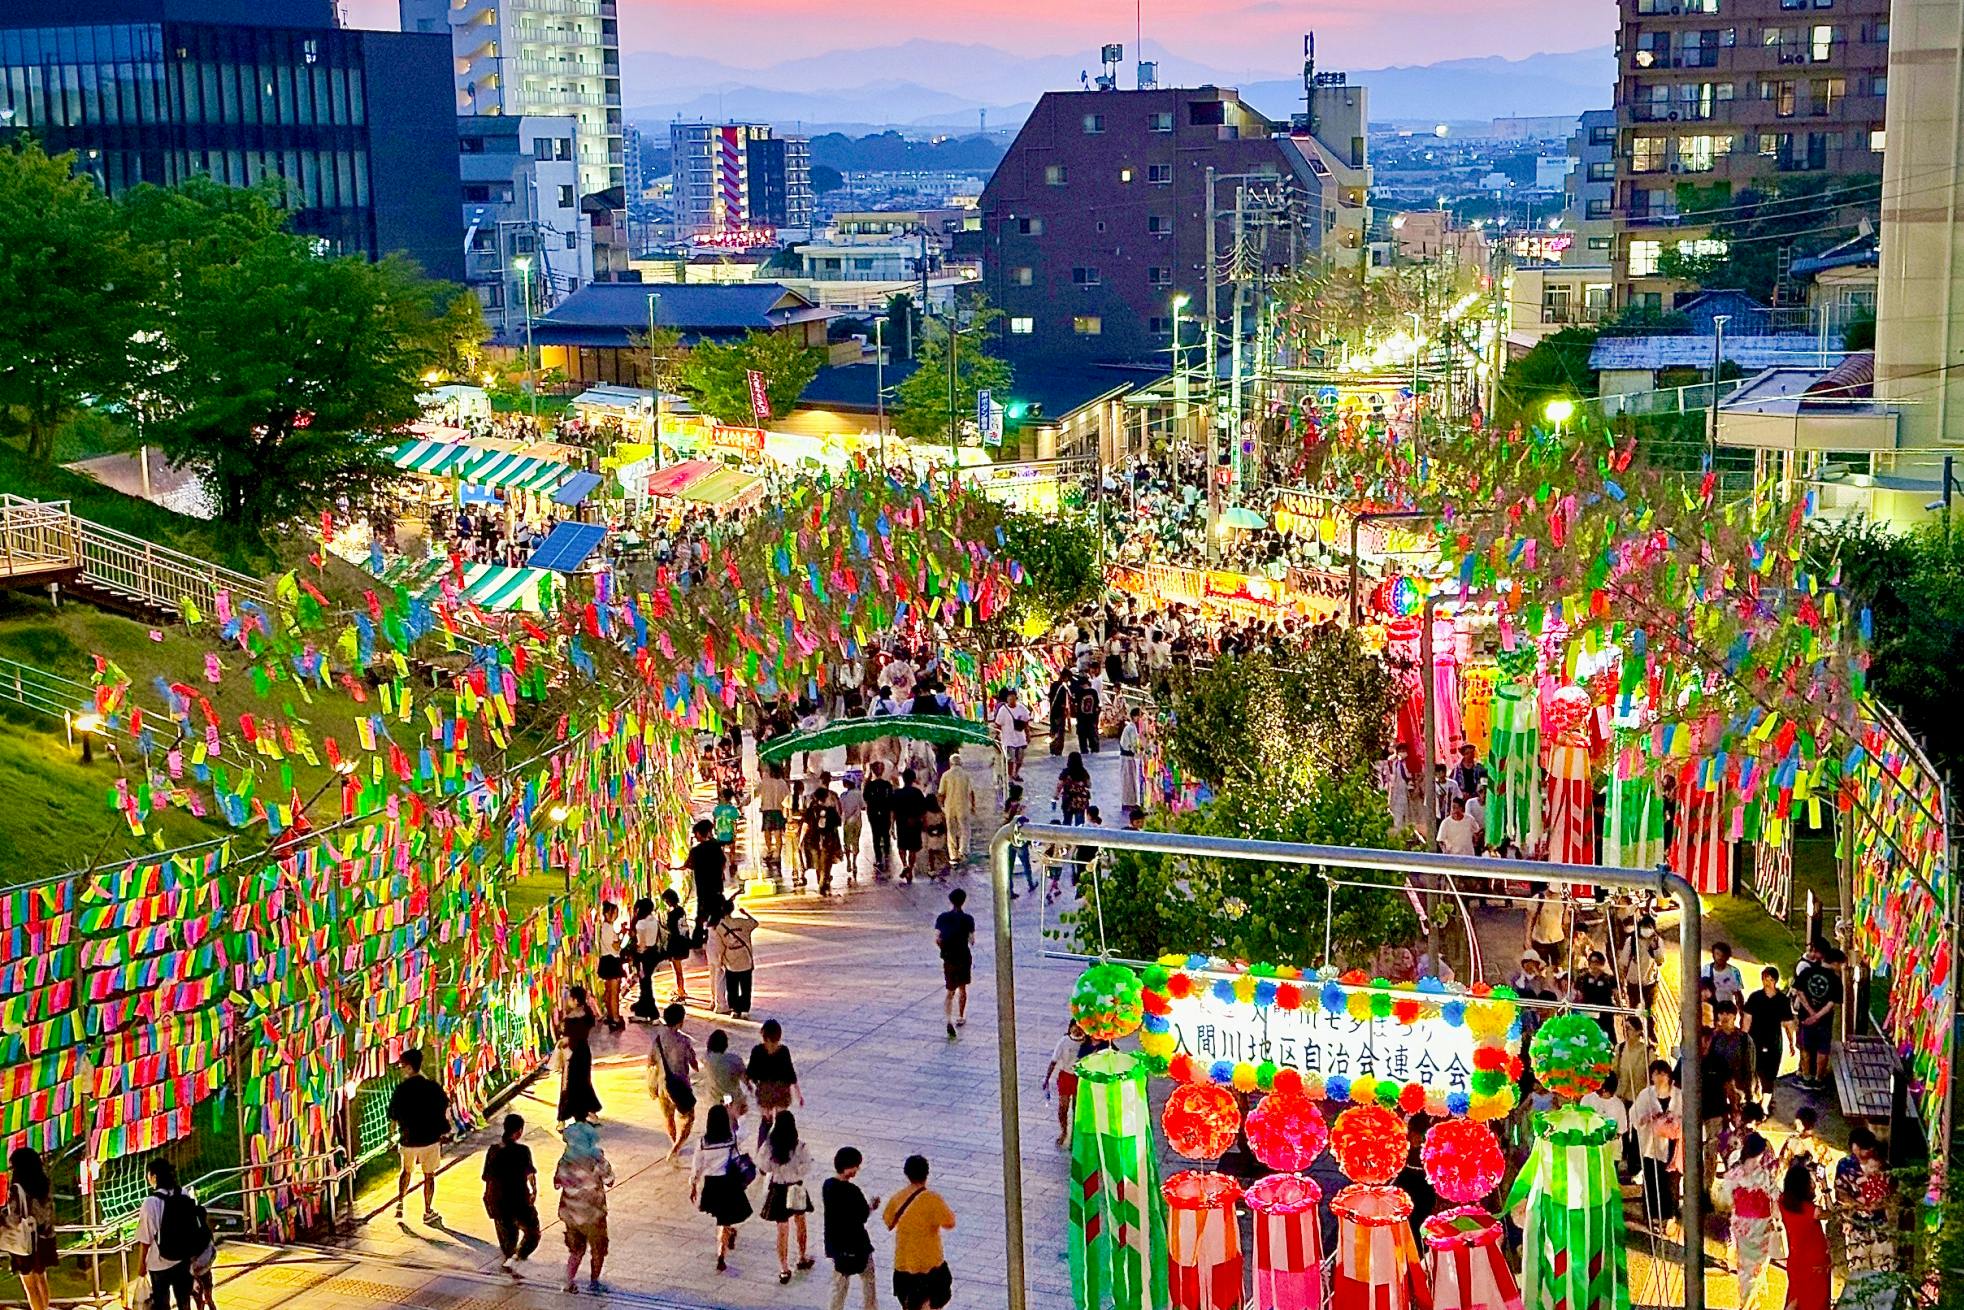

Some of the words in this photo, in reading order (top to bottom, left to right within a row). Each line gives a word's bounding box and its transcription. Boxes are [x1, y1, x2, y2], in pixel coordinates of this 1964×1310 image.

[1172, 1022, 1471, 1091] 入間川地区自治会連合会
